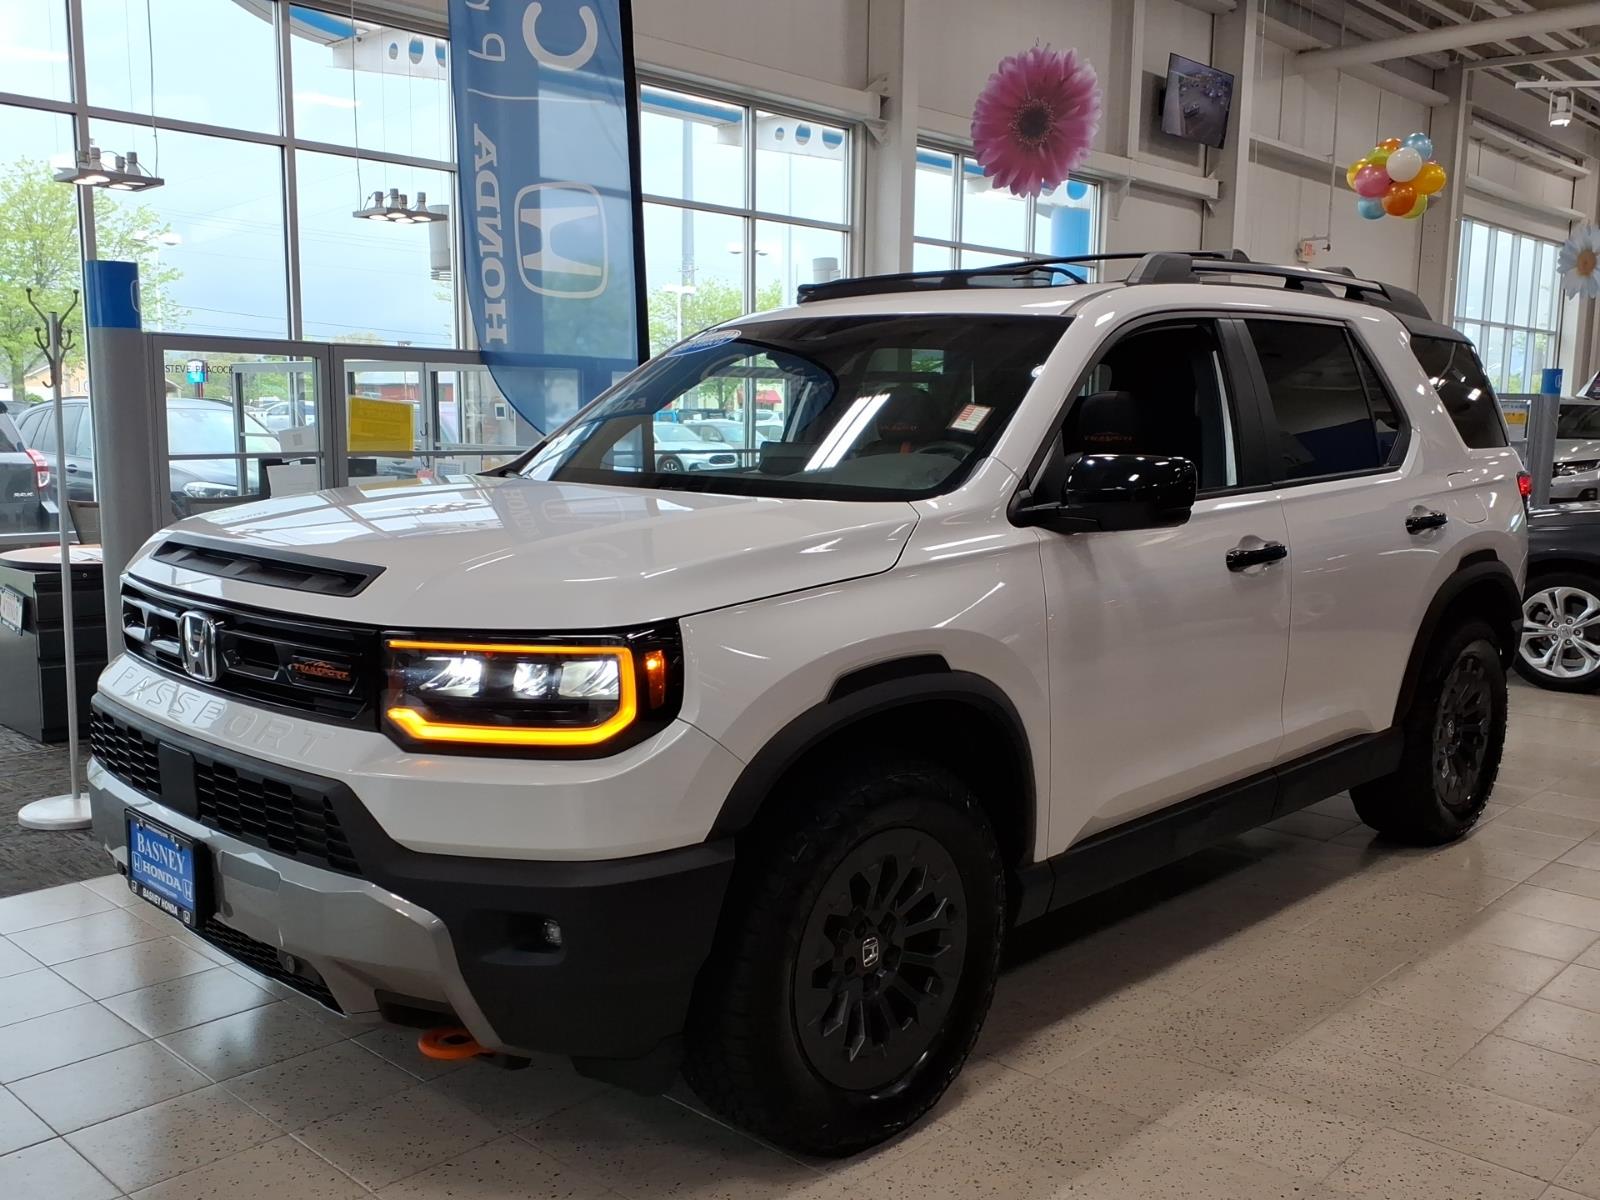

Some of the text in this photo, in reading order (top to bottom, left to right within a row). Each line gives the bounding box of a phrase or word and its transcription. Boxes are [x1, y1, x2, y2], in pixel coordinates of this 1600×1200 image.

[165, 364, 234, 375] STEVE PACOCK
[102, 666, 336, 756] PASSPORT
[136, 832, 186, 874] BASNEY
[142, 860, 183, 892] HONDA
[142, 887, 161, 906] BASNEY
[161, 897, 178, 916] HONDA
